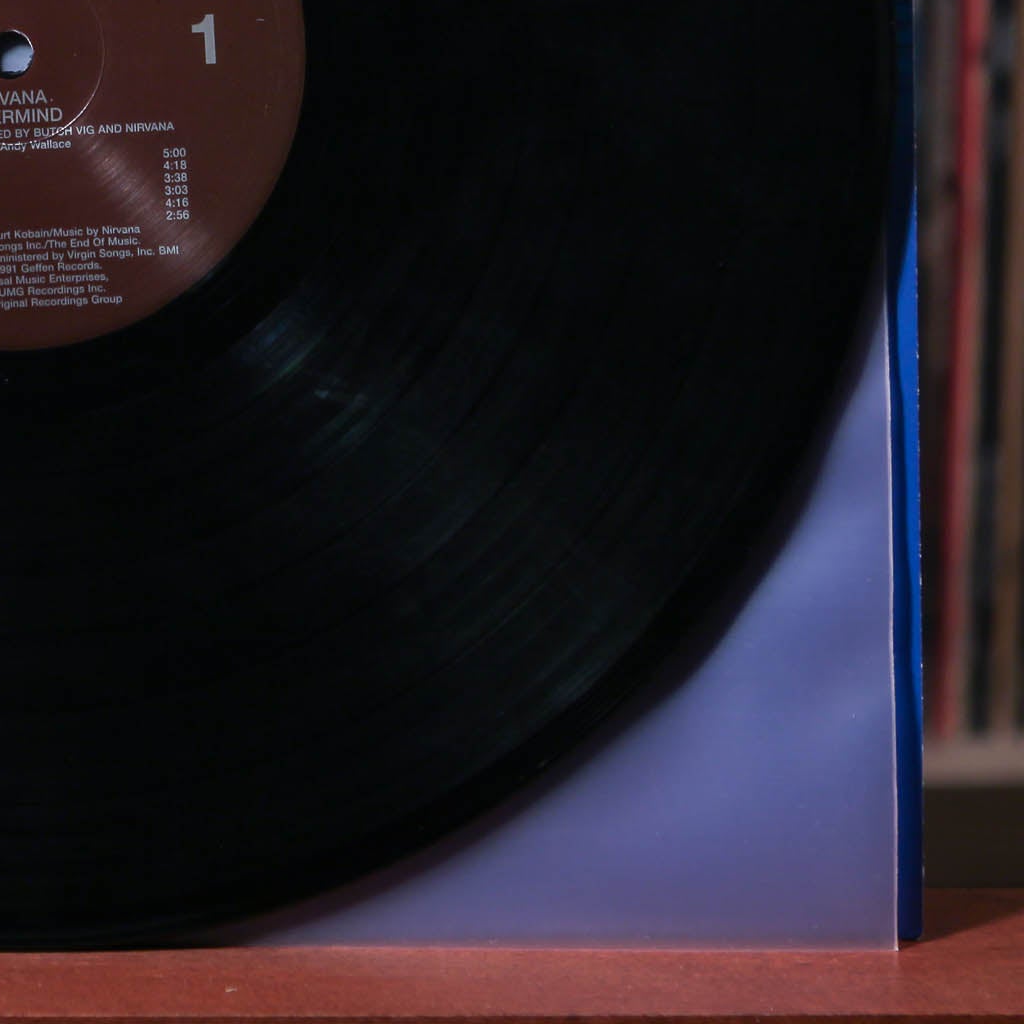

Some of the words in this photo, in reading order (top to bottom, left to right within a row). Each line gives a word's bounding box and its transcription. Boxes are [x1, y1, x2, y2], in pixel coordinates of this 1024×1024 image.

[191, 14, 216, 64] 1
[15, 129, 29, 138] BY
[34, 127, 73, 137] BUTCH
[76, 125, 94, 135] VIG
[98, 124, 122, 134] AND
[126, 122, 174, 133] NIRVANA
[0, 143, 26, 152] Andy
[29, 140, 71, 150] Wallace
[163, 148, 186, 158] 5:00
[163, 160, 187, 170] 4:18
[164, 173, 187, 183] 3:38
[165, 185, 188, 195] 3:03
[165, 198, 188, 208] 4:16
[166, 210, 189, 220] 2:56
[86, 227, 98, 237] by
[102, 226, 140, 234] Nirvana
[70, 238, 89, 247] End
[93, 237, 105, 246] Of
[52, 251, 64, 261] by
[67, 250, 96, 261] Virgin
[137, 247, 155, 256] Inc.
[159, 246, 179, 255] BMI
[21, 263, 54, 273] Geffen
[0, 287, 24, 297] UMG
[28, 284, 84, 295] Recordings
[88, 284, 106, 293] Inc.
[32, 297, 88, 307] Recordings
[92, 295, 122, 304] Group
